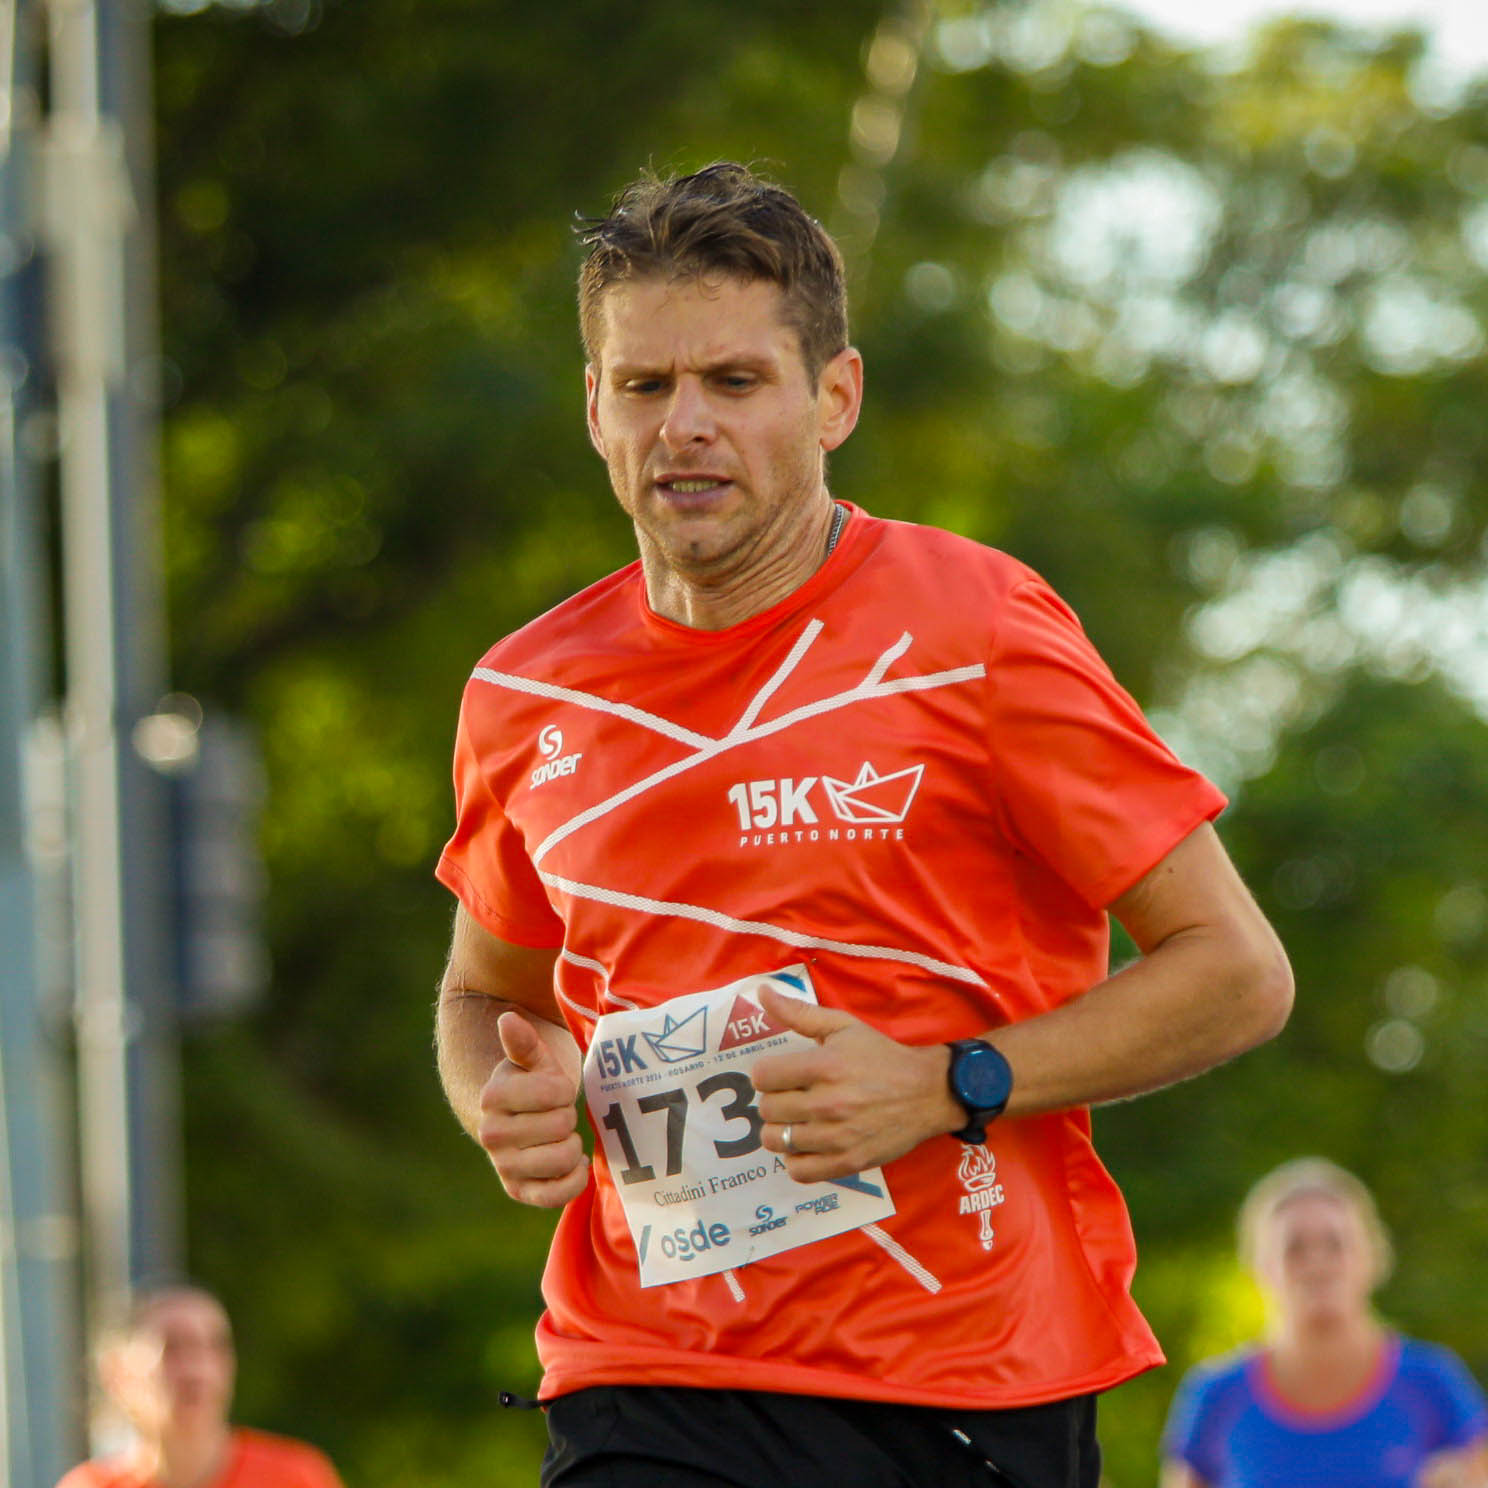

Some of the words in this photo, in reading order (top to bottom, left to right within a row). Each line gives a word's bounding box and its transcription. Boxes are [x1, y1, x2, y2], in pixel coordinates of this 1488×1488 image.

[728, 777, 819, 831] 15K
[728, 1012, 771, 1040] 15K
[597, 1034, 648, 1079] 15K
[668, 1061, 704, 1076] ROSARIO
[726, 1051, 737, 1060] DE
[740, 1043, 765, 1056] ABRIL
[654, 1181, 706, 1206] Cittadini
[707, 1165, 767, 1194] Franco
[960, 1184, 1005, 1215] ARDEC
[661, 1218, 730, 1259] osde
